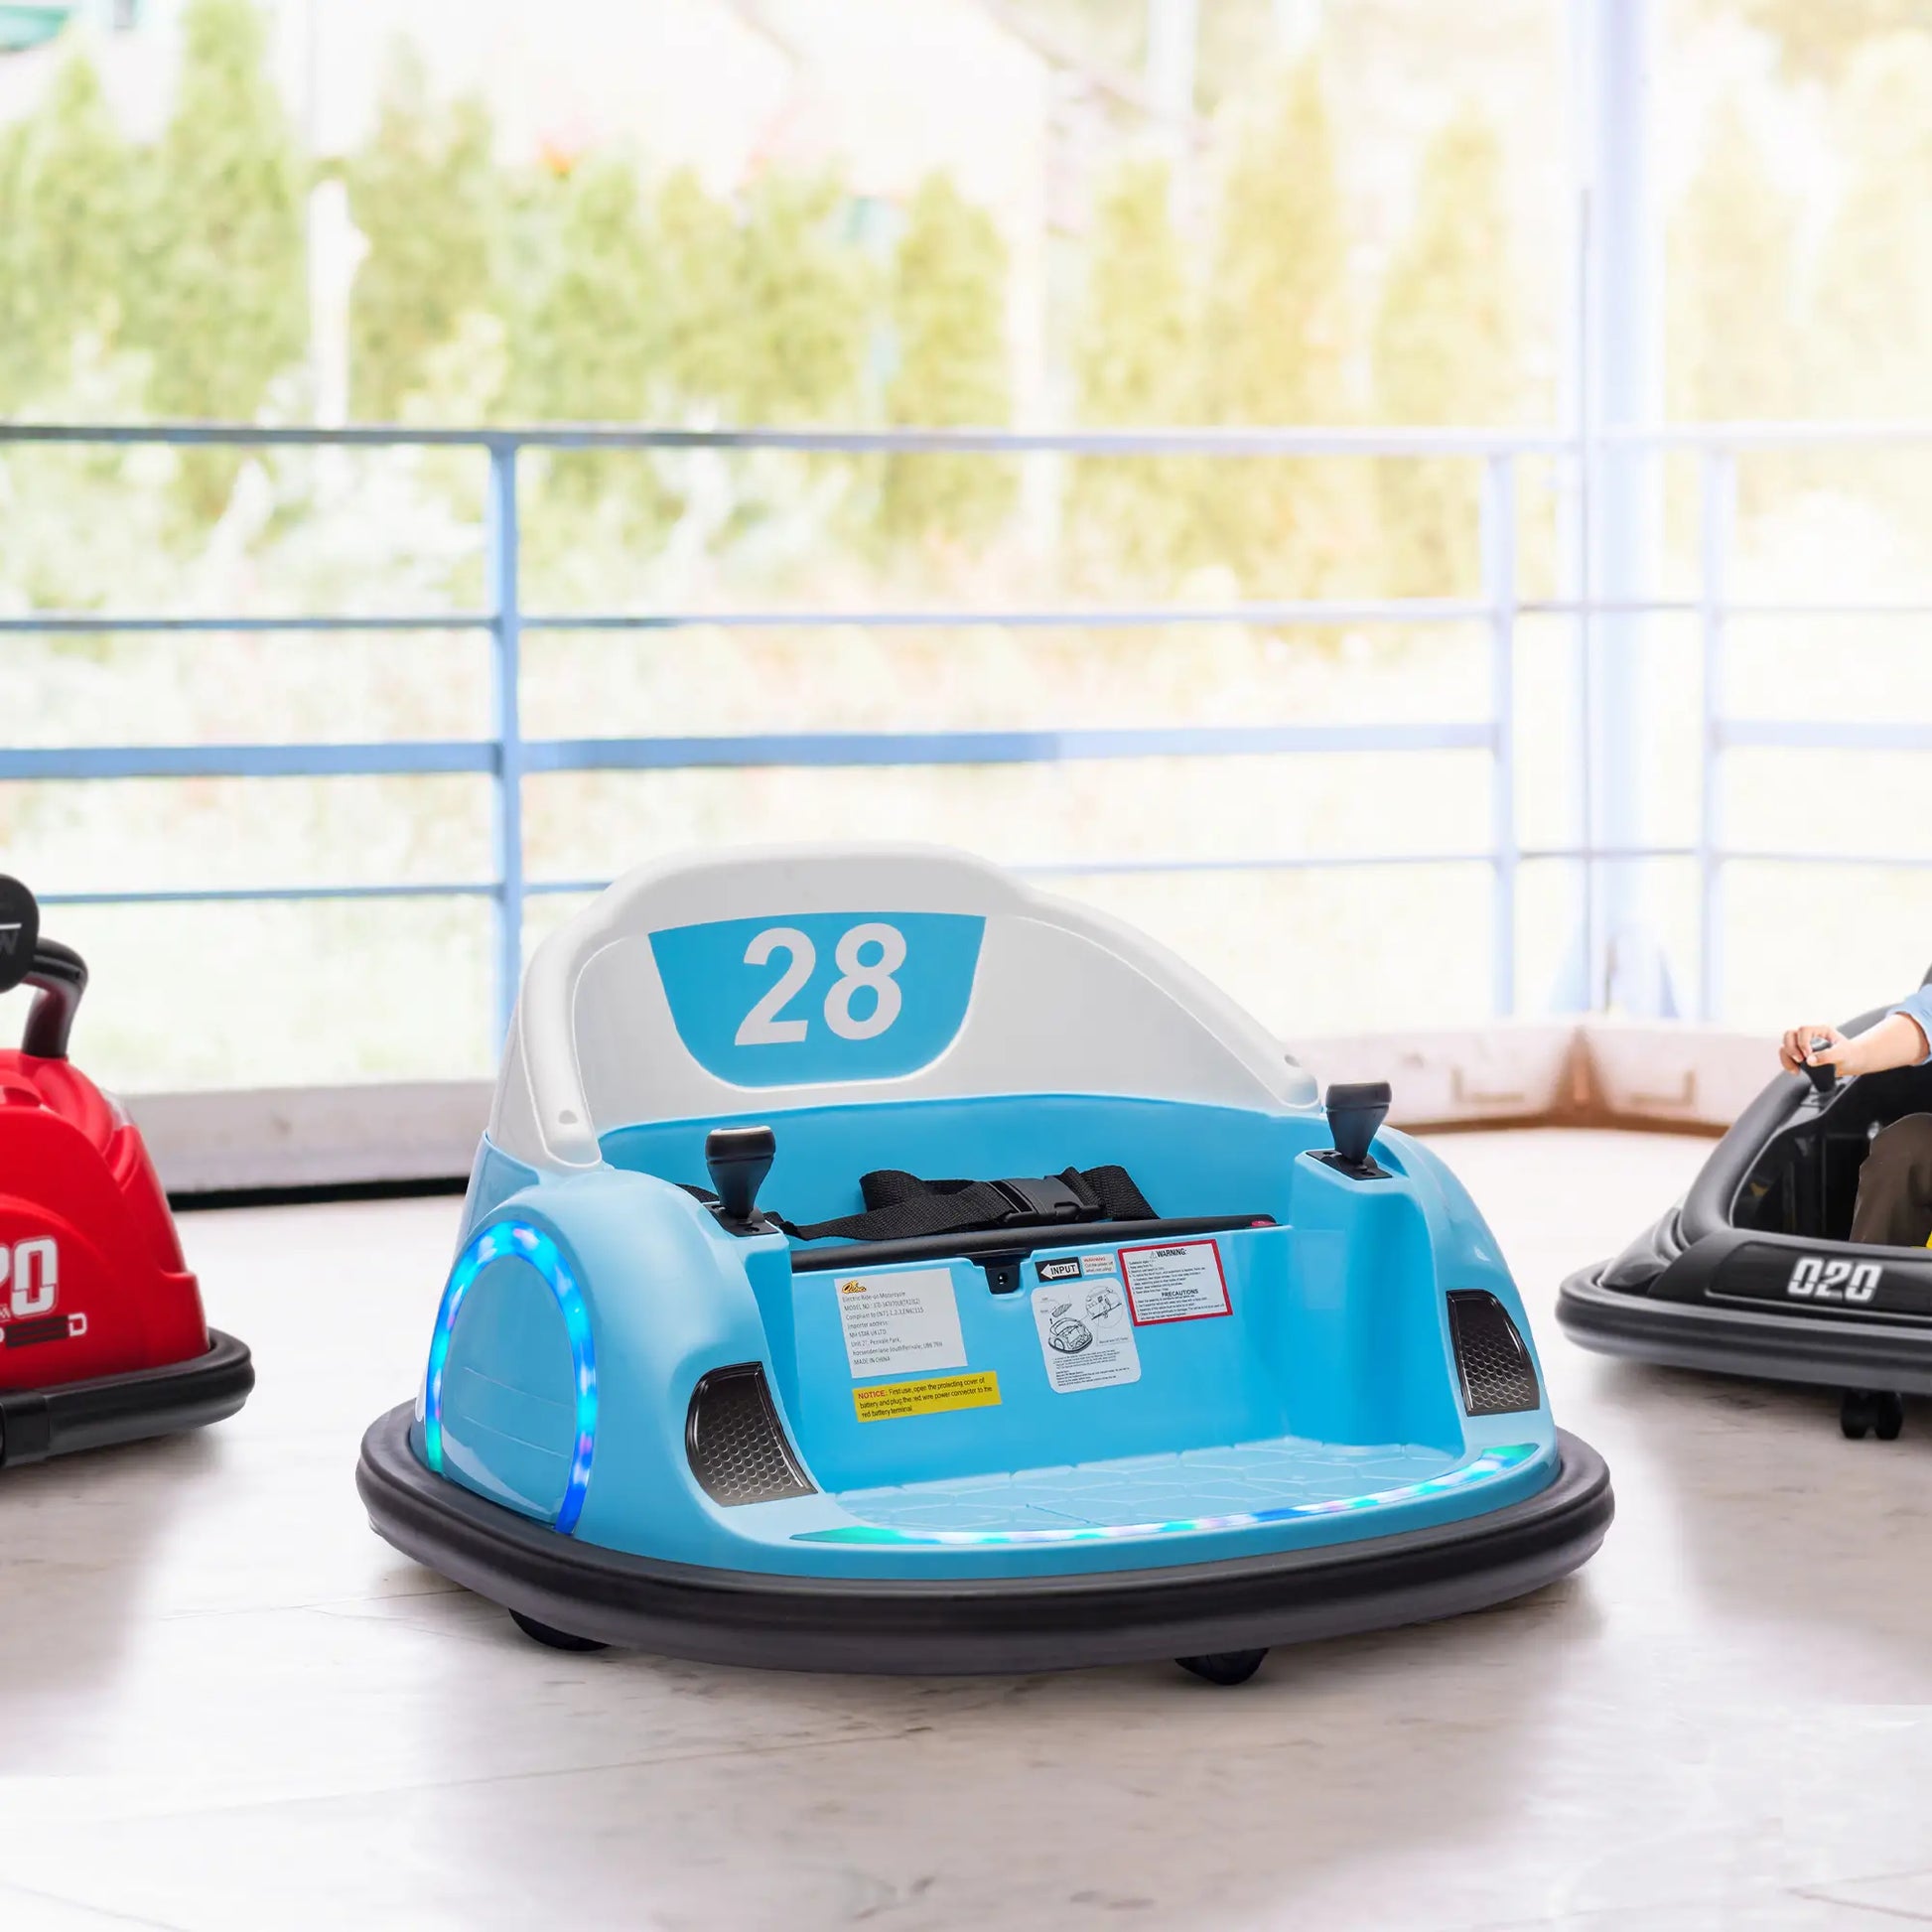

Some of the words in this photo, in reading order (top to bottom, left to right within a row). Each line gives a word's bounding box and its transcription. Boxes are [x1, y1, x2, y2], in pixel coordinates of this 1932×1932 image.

[735, 922, 906, 1045] 28
[0, 1238, 58, 1318] 0
[1050, 1265, 1075, 1275] INPUT
[1787, 1256, 1882, 1302] 020
